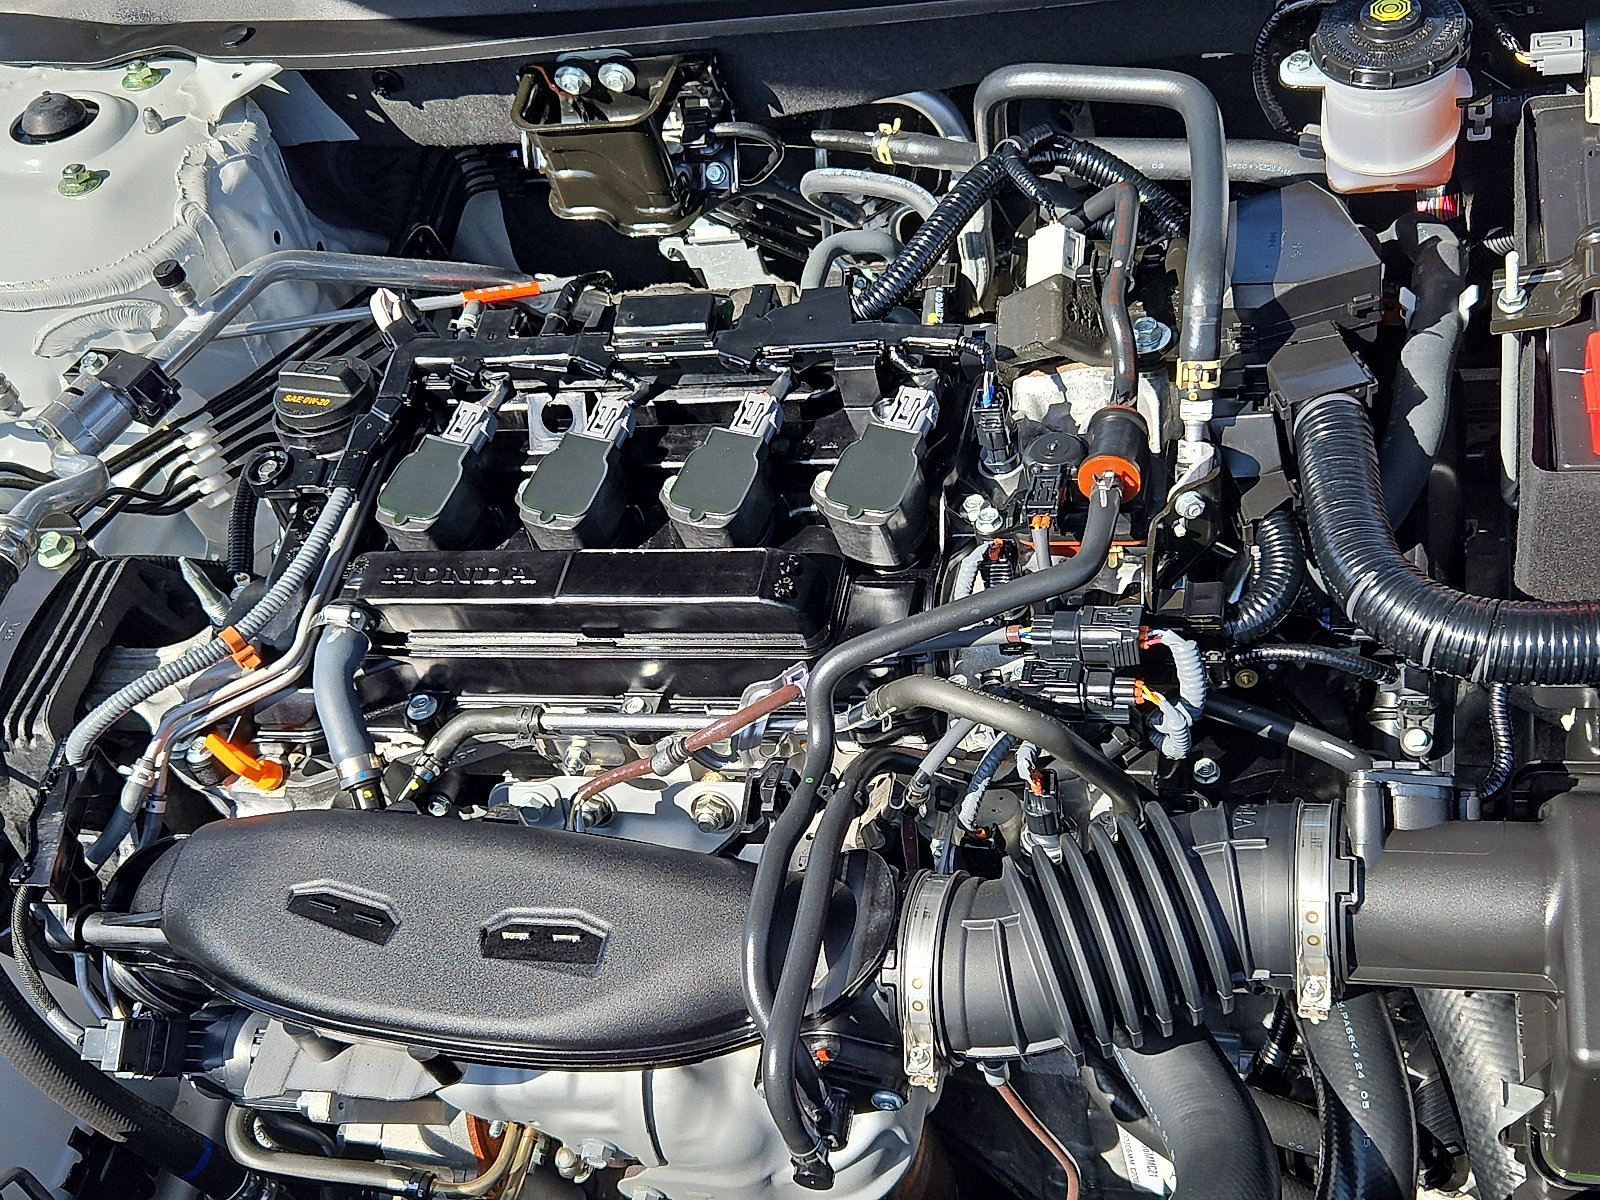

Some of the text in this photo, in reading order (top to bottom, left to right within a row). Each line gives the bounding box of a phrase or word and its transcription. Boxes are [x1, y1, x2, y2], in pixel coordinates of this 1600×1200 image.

[283, 394, 331, 406] SAE 0W-20
[380, 567, 537, 585] HONDA
